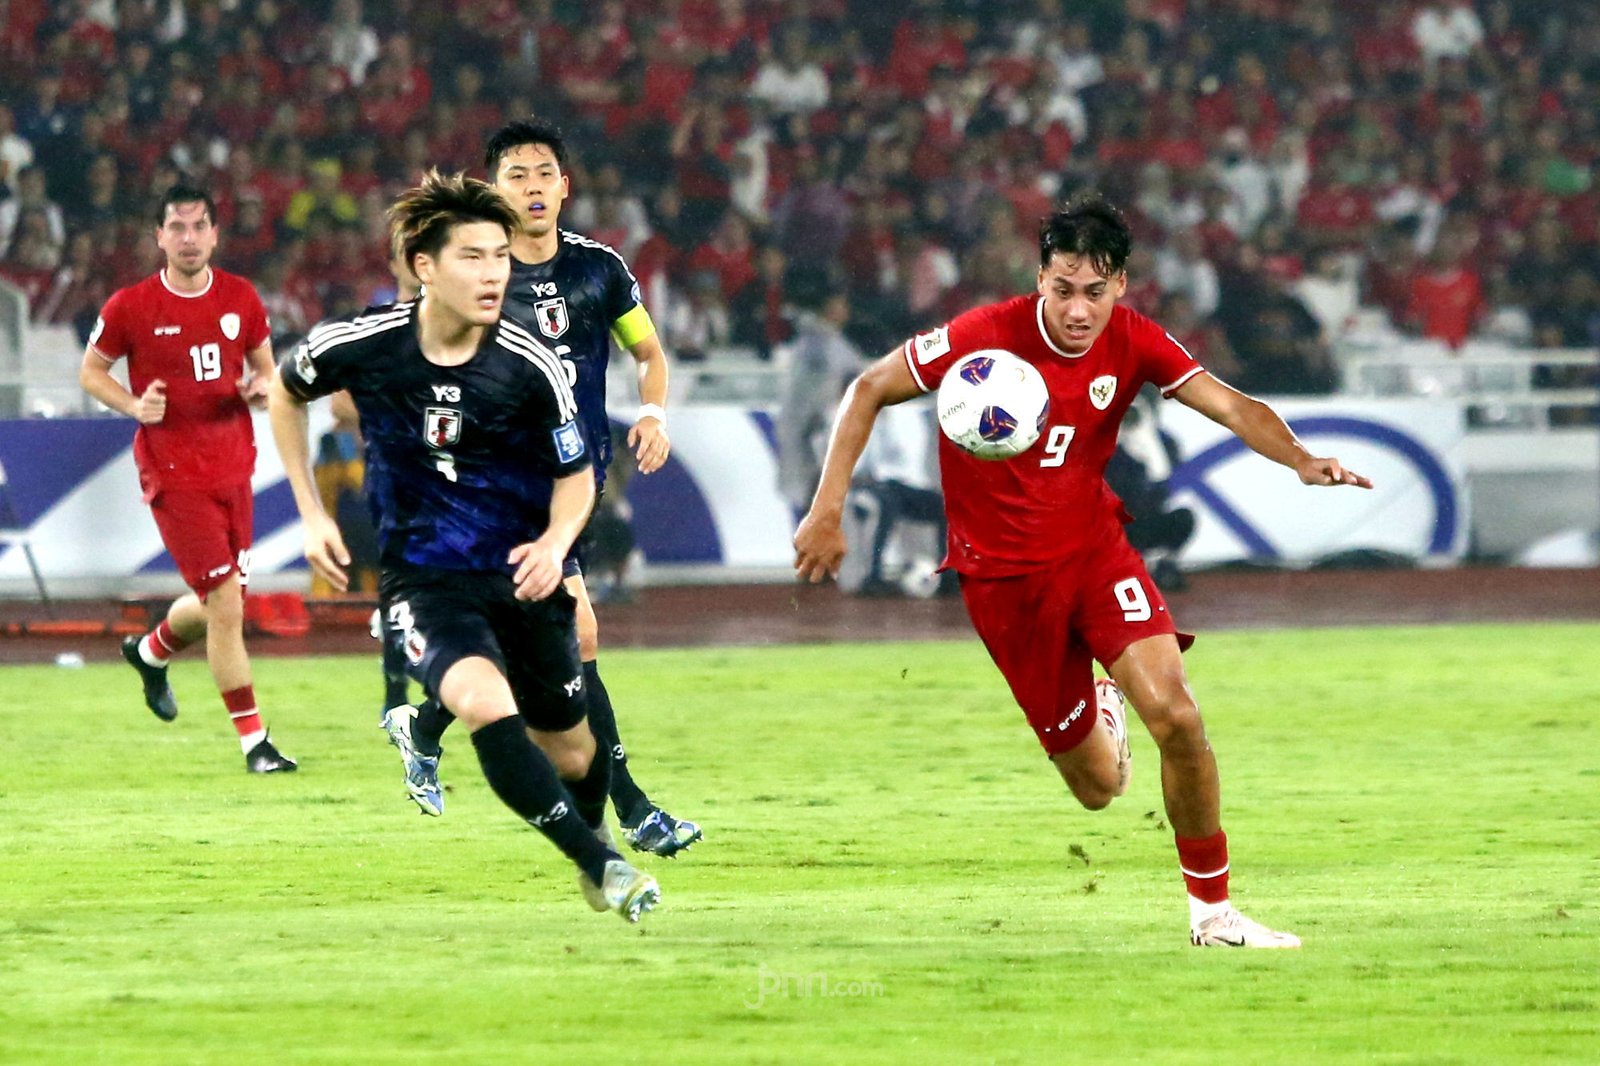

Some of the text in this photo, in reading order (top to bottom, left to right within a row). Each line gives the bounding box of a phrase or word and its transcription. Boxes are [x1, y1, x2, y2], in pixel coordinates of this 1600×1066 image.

[531, 282, 558, 297] Y-3
[189, 343, 222, 382] 19
[431, 385, 461, 403] Y-3
[1039, 425, 1076, 468] 9
[1113, 577, 1153, 622] 9
[563, 675, 582, 697] Y-3
[1058, 699, 1087, 732] erspo
